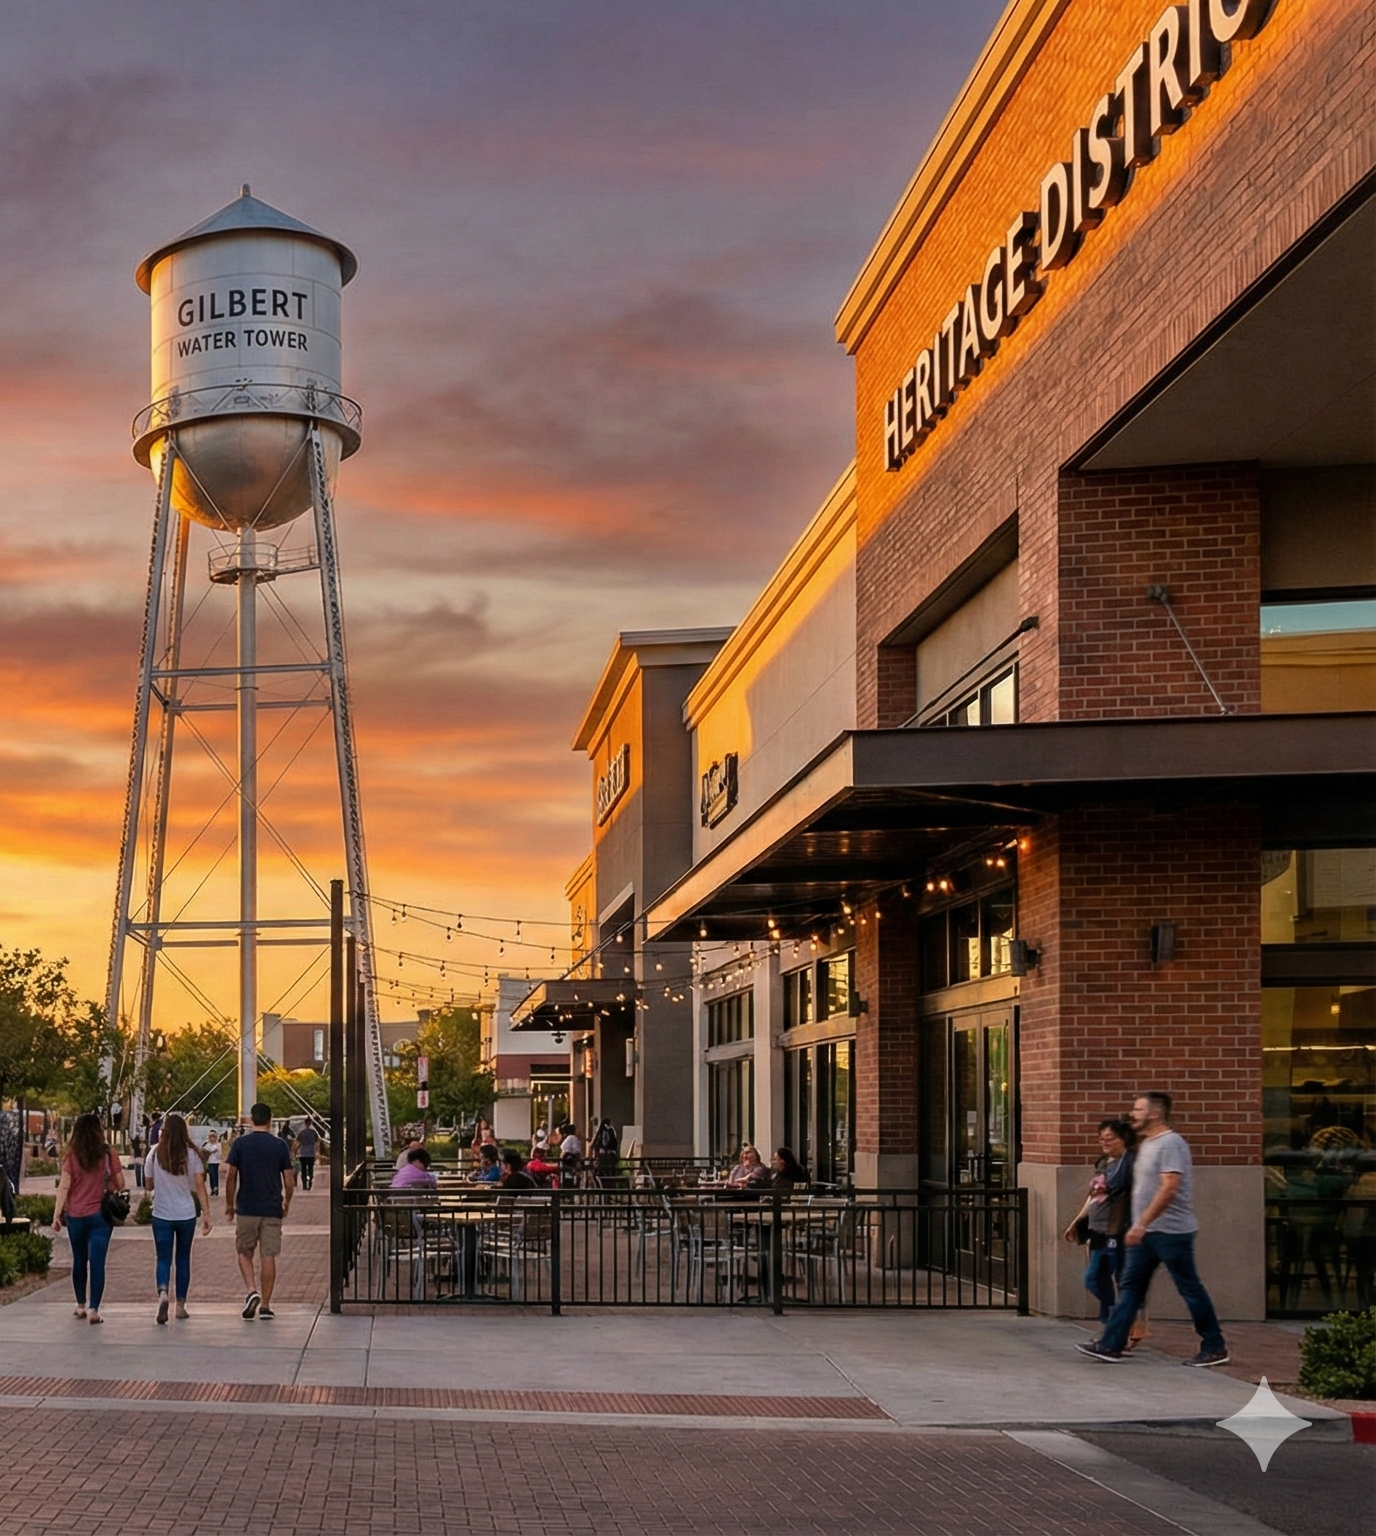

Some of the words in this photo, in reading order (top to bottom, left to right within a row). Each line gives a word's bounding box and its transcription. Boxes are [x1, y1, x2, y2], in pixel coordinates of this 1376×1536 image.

[177, 288, 307, 327] GILBERT
[178, 331, 236, 358] WATER
[243, 329, 308, 351] TOWER
[884, 211, 1036, 472] HERITAGE
